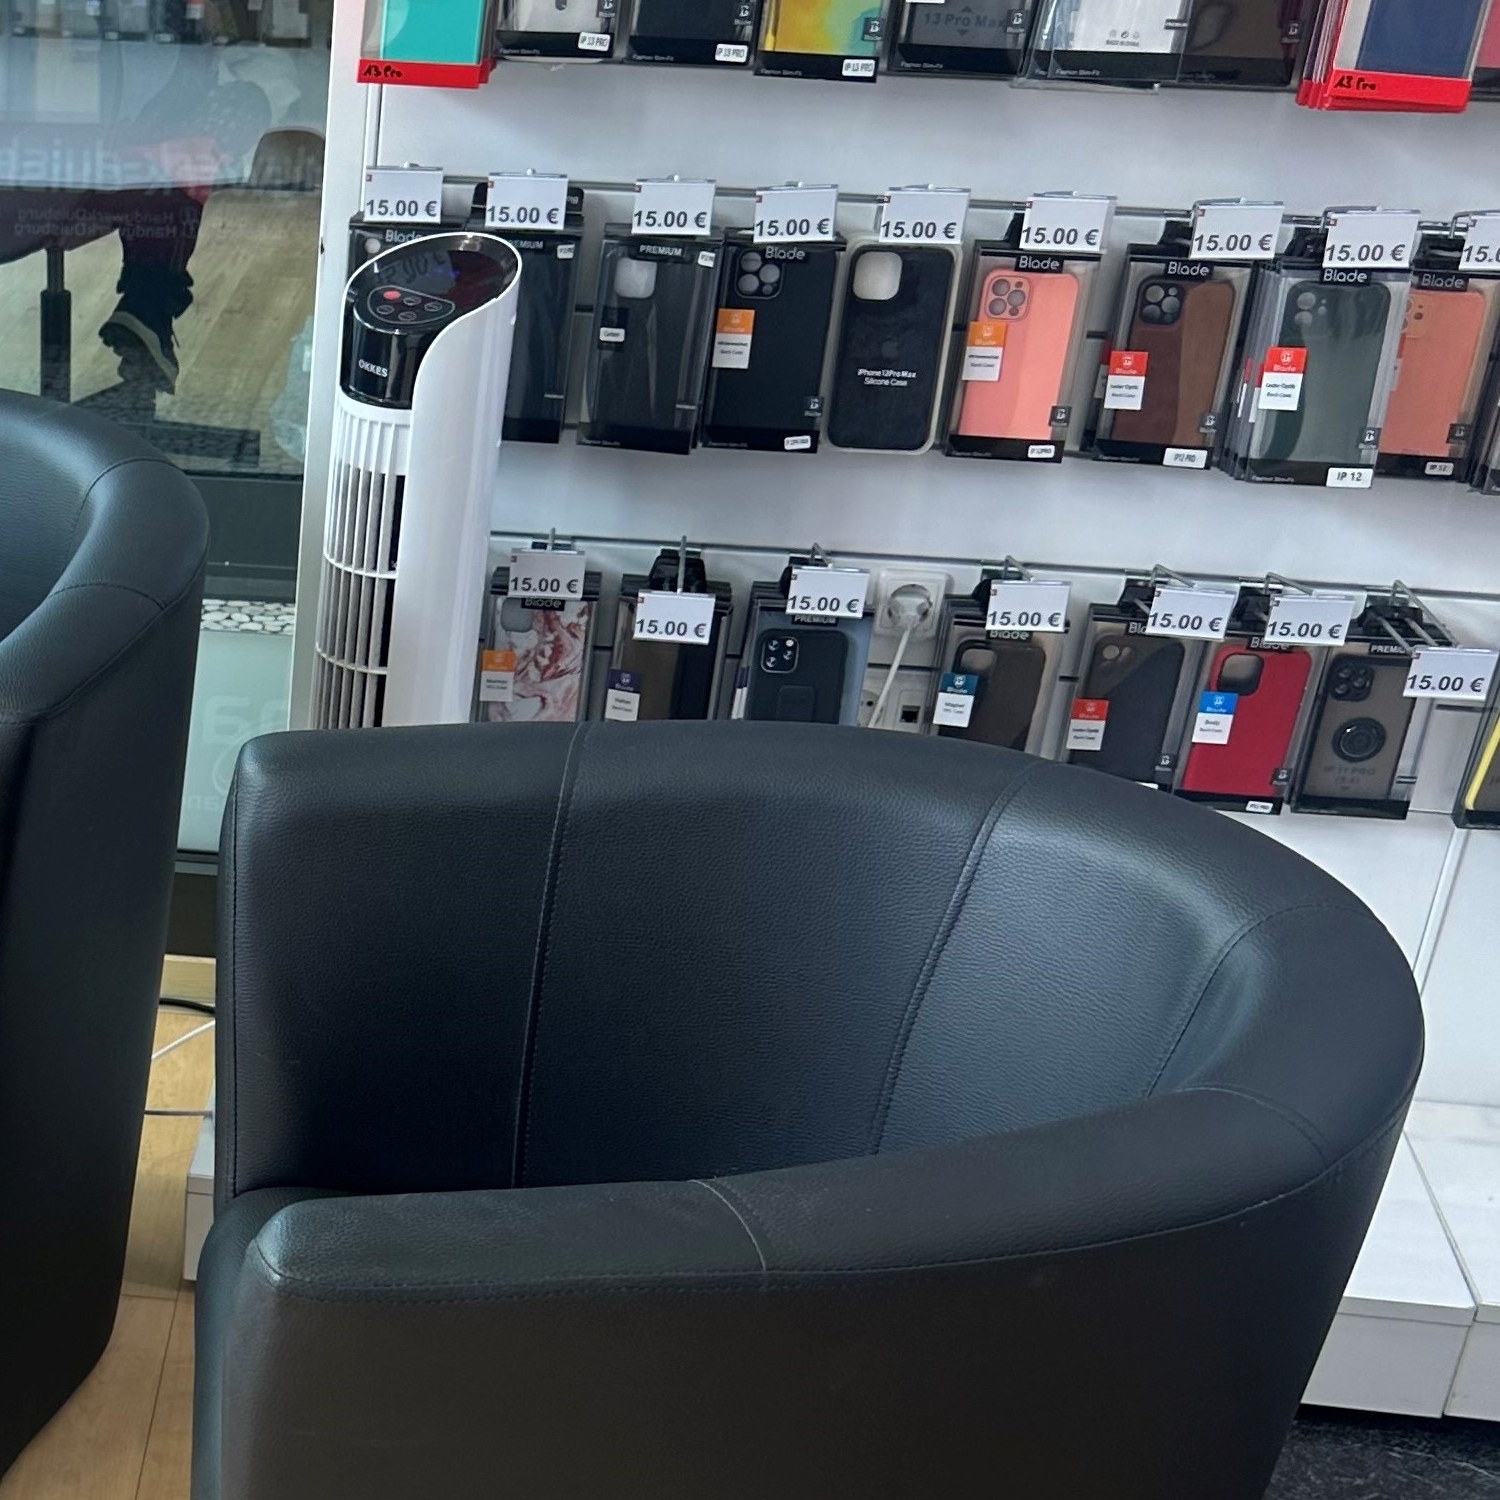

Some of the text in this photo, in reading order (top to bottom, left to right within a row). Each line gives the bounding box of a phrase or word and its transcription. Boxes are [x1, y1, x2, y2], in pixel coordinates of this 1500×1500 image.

[924, 12, 942, 25] 13
[945, 14, 971, 27] Pro
[732, 48, 745, 58] PRO
[366, 199, 438, 218] 15.00 €
[488, 206, 560, 225] 15.00 €
[634, 210, 708, 228] 15.00 €
[756, 218, 830, 237] 15.00 €
[880, 221, 957, 239] 15.00 €
[1022, 226, 1100, 246] 15.00 €
[639, 244, 682, 256] PREMIUM
[1195, 234, 1274, 251] 15.00 €
[765, 246, 806, 261] Blade
[1324, 244, 1406, 262] 15.00 €
[1018, 256, 1060, 272] Blade
[1167, 261, 1210, 278] Blade
[1323, 268, 1368, 284] Blade
[1422, 274, 1464, 288] Blade
[358, 359, 388, 378] OKKES
[1336, 472, 1362, 481] IP 12
[510, 577, 580, 594] 15.00 €
[788, 596, 860, 614] 15.00 €
[636, 618, 707, 638] 15.00 €
[988, 611, 1061, 627] 15.00 €
[1150, 612, 1223, 632] 15.00 €
[1268, 621, 1342, 640] 15.00 €
[1407, 674, 1486, 693] 15.00 €
